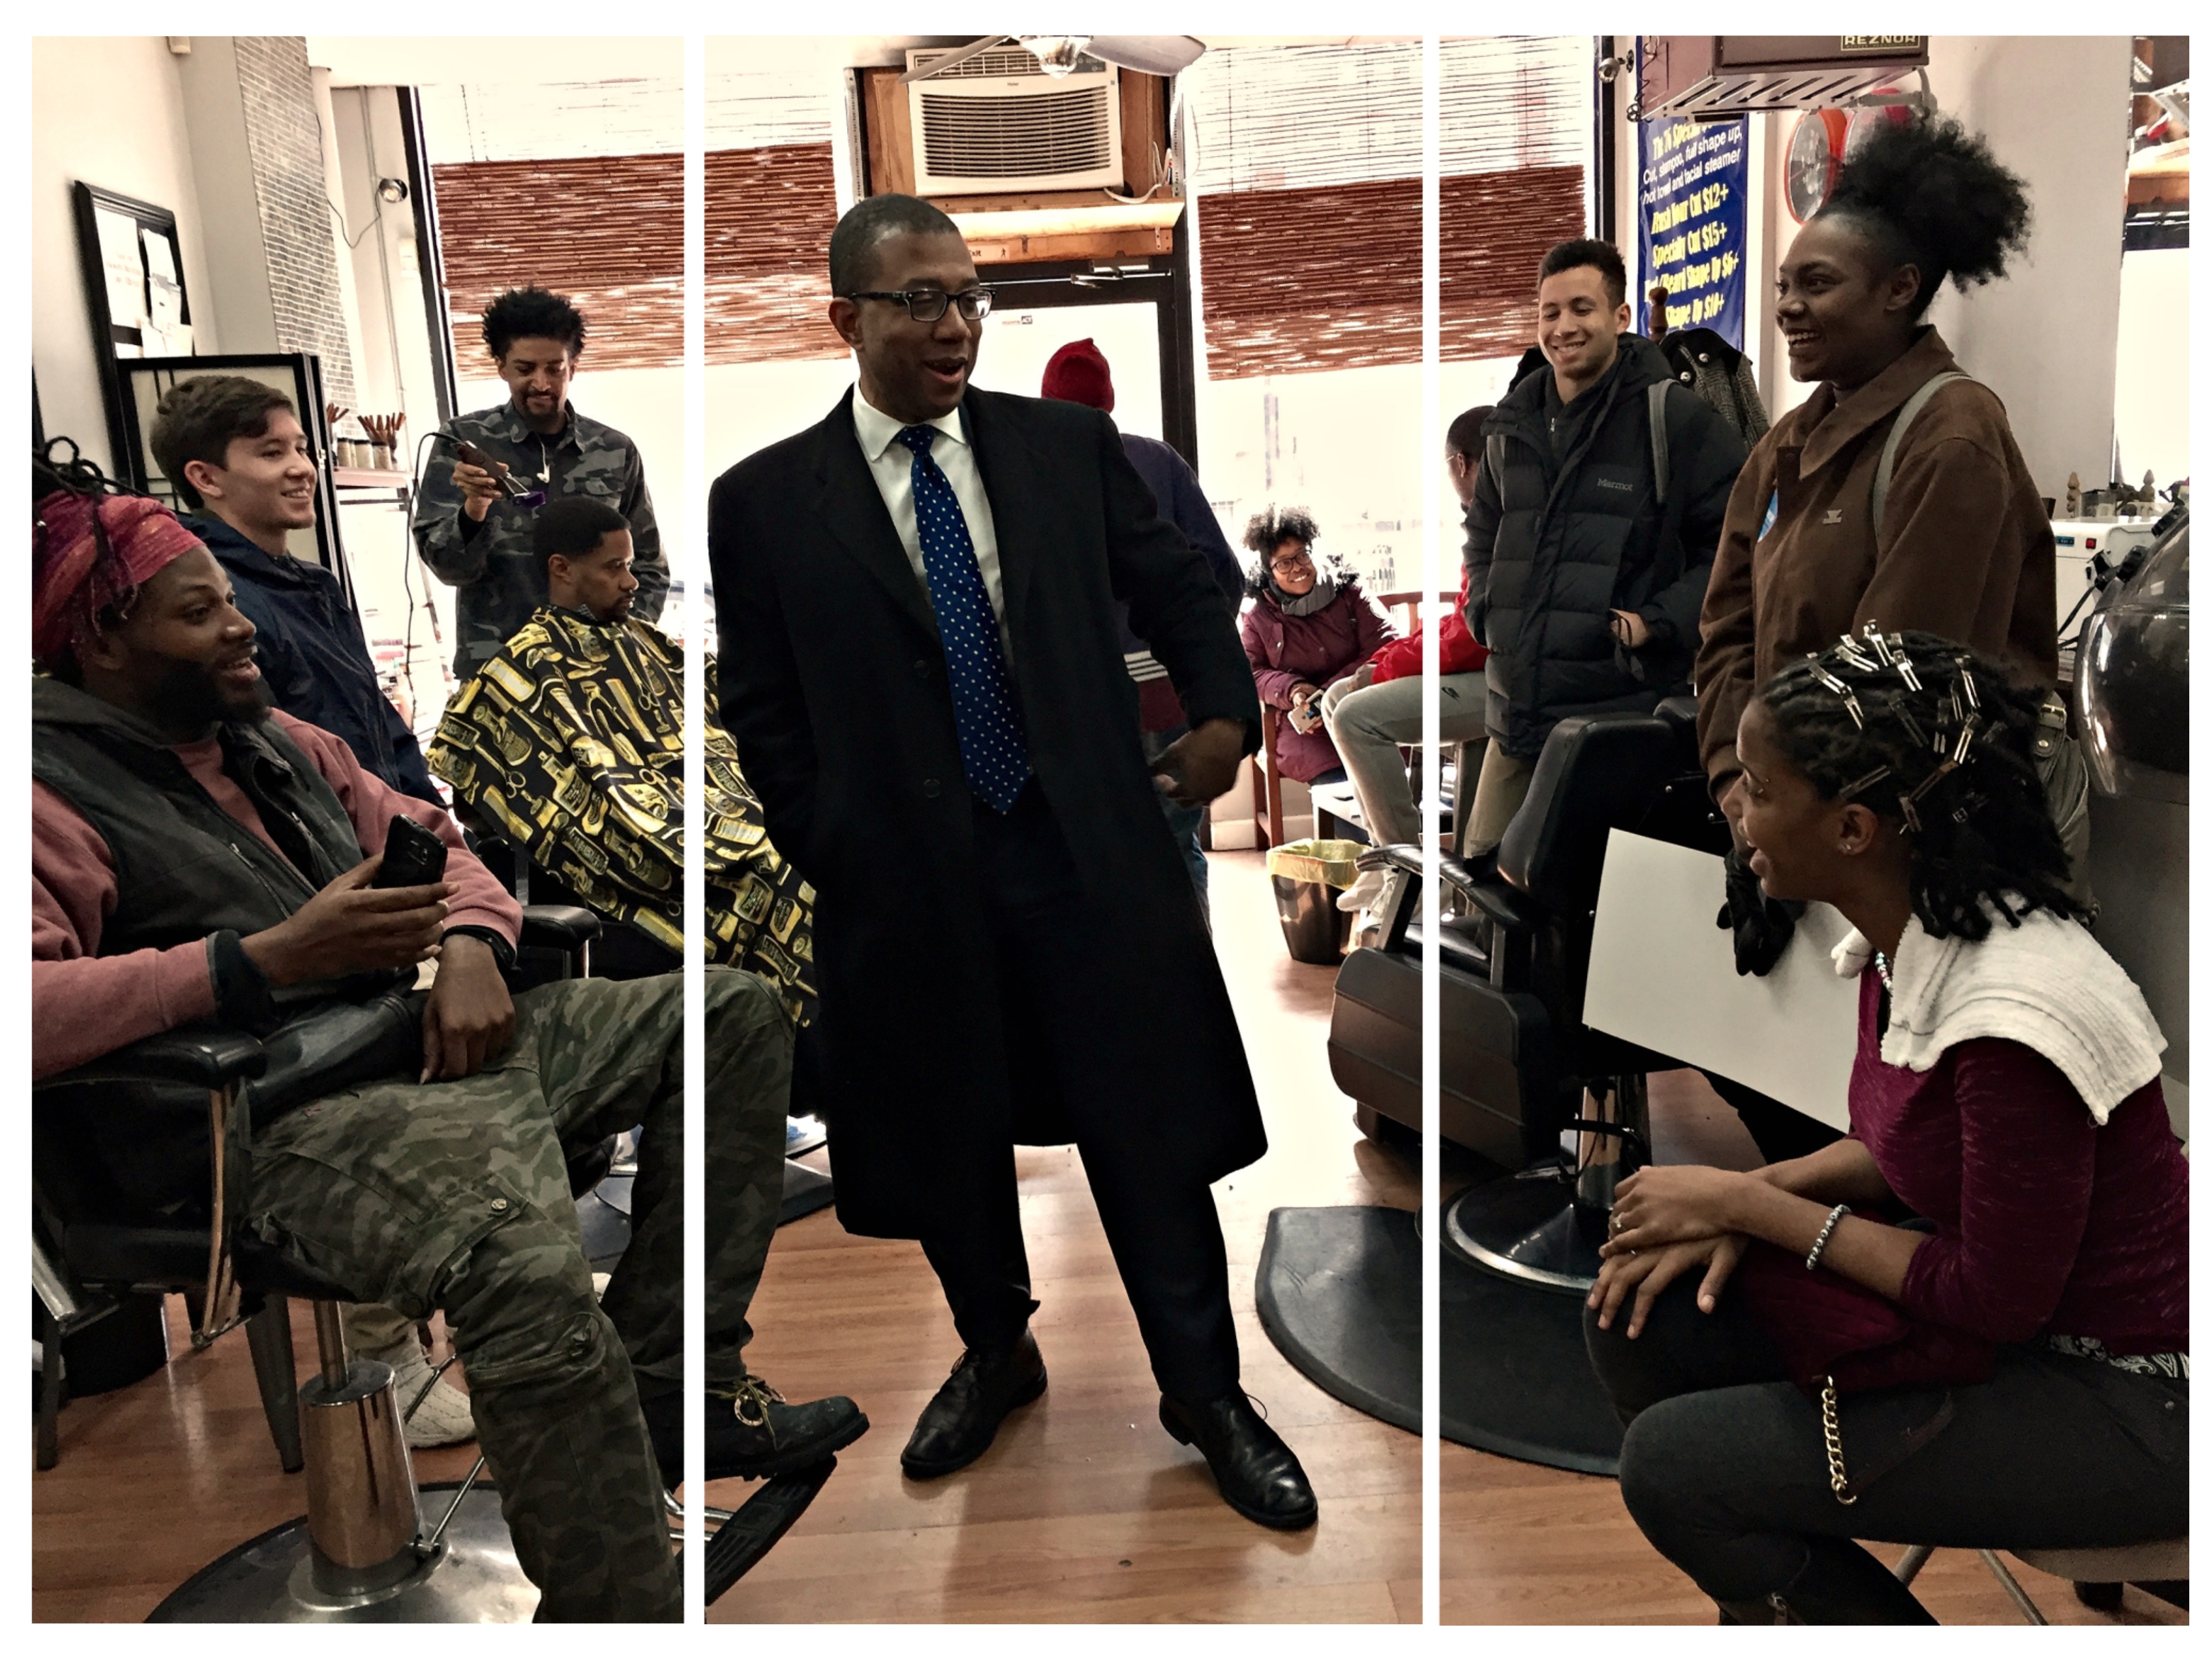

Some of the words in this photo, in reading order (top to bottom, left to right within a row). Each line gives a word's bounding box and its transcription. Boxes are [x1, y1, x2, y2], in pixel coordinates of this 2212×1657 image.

[1844, 35, 1915, 45] REZNOR
[1686, 141, 1697, 162] full
[1698, 131, 1727, 155] shape
[1728, 125, 1743, 145] up,
[1642, 190, 1657, 205] hot
[1672, 170, 1685, 191] and
[1685, 161, 1703, 185] facial
[1704, 148, 1742, 175] steamer
[1690, 190, 1703, 218] Cut
[1702, 182, 1729, 214] $12+
[1652, 235, 1687, 270] Specialty
[1687, 227, 1702, 255] Cut
[1701, 220, 1728, 251] $15+
[1686, 262, 1711, 289] Shape
[1665, 303, 1692, 329] Shape
[1597, 478, 1633, 491] Marmot
